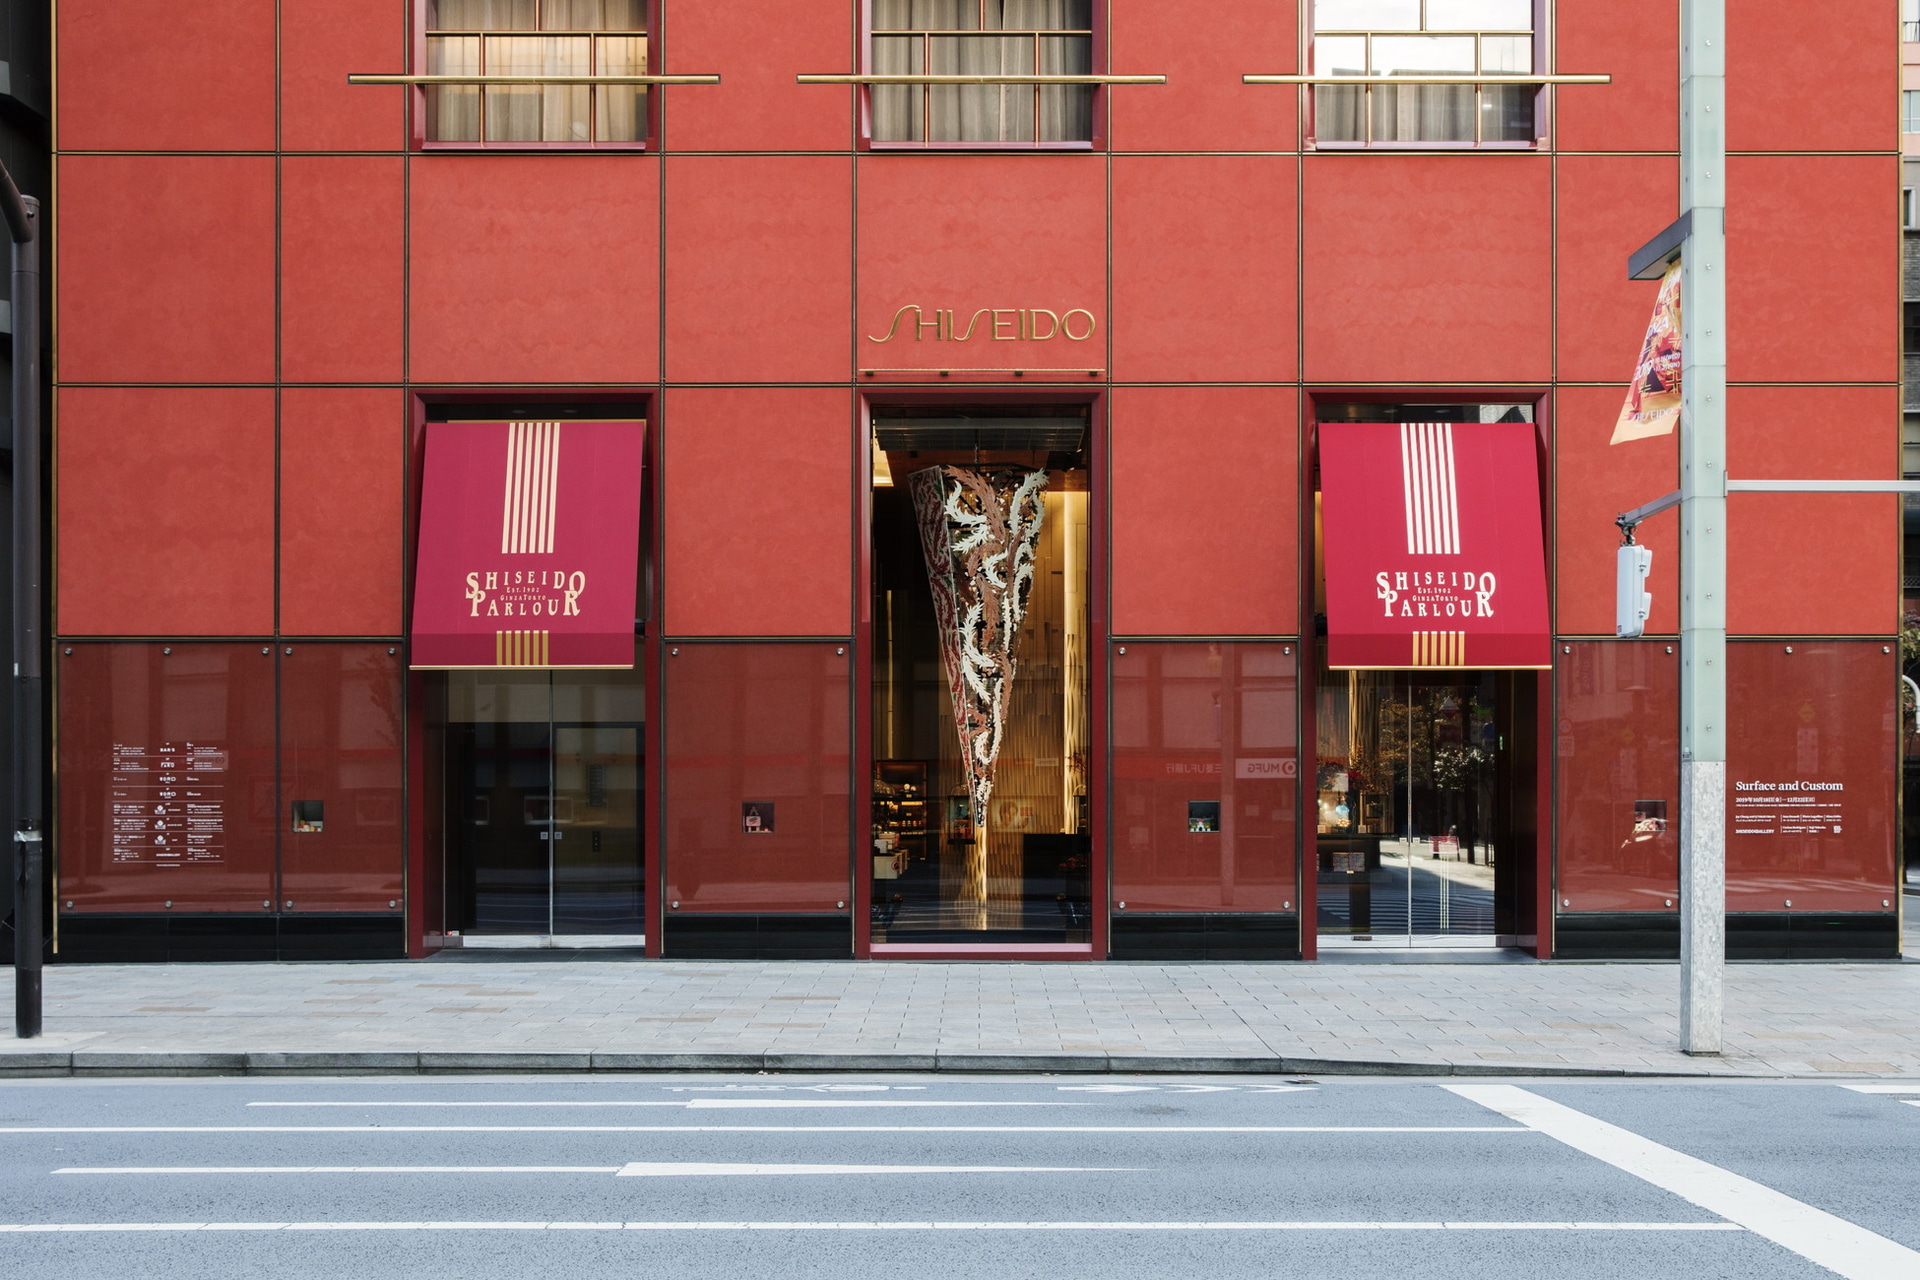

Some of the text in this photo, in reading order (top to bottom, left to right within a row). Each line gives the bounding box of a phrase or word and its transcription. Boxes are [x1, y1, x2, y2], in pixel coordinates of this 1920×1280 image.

[868, 304, 1096, 343] SHISEIDO
[465, 571, 586, 599] SHISEIDO
[1376, 571, 1497, 599] SHISEIDO
[470, 590, 581, 617] PARLOUR
[1384, 590, 1495, 618] PARLOUR
[1735, 781, 1844, 791] Surface and Custom
